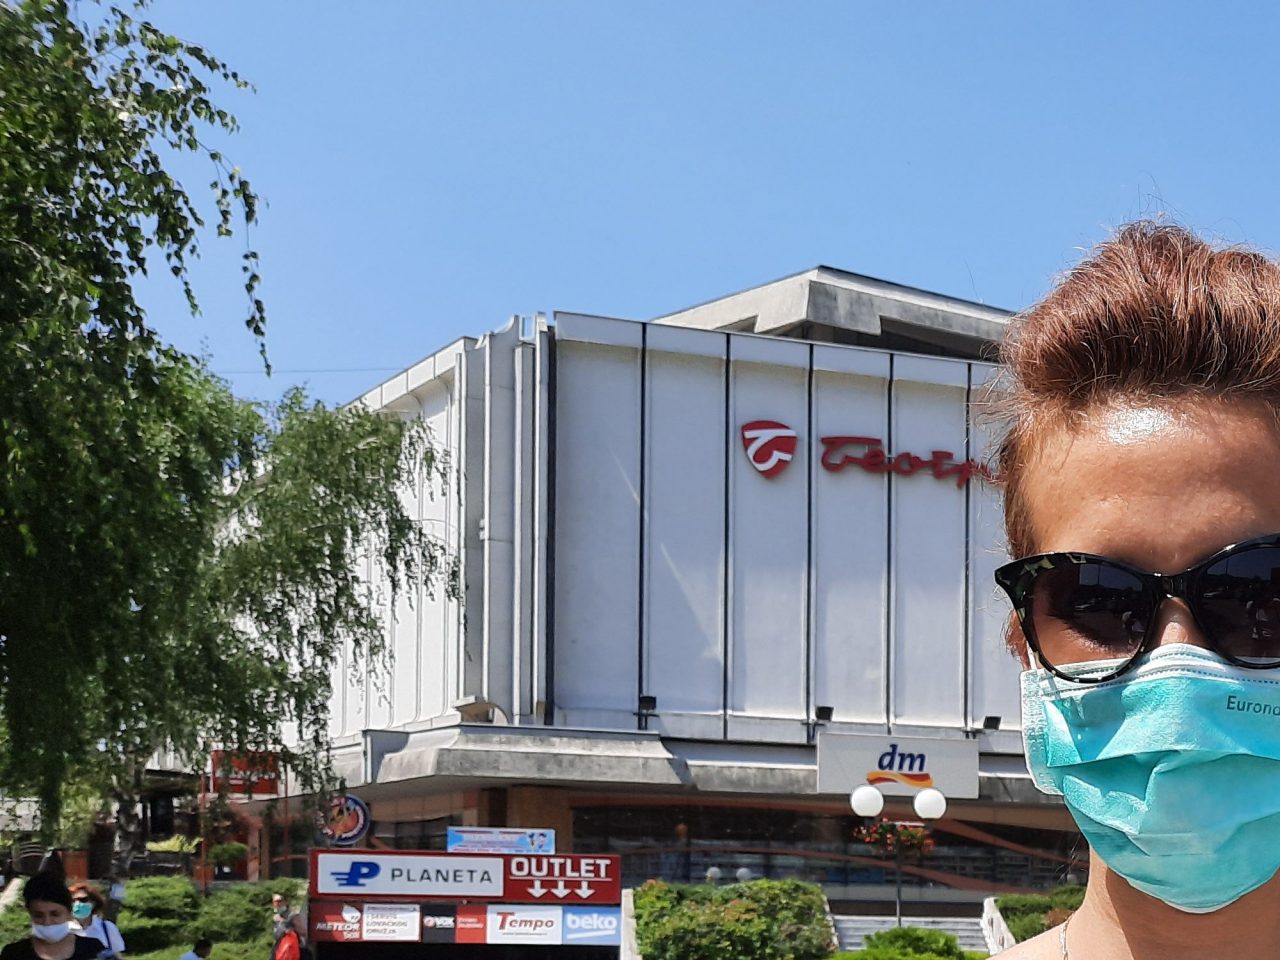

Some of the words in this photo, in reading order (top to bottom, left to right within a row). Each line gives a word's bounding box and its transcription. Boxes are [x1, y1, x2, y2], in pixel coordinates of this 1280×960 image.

[878, 744, 926, 772] dm
[391, 868, 492, 884] PLANETA
[511, 857, 611, 878] OUTLET
[496, 912, 554, 931] Tempo
[566, 913, 617, 930] beko
